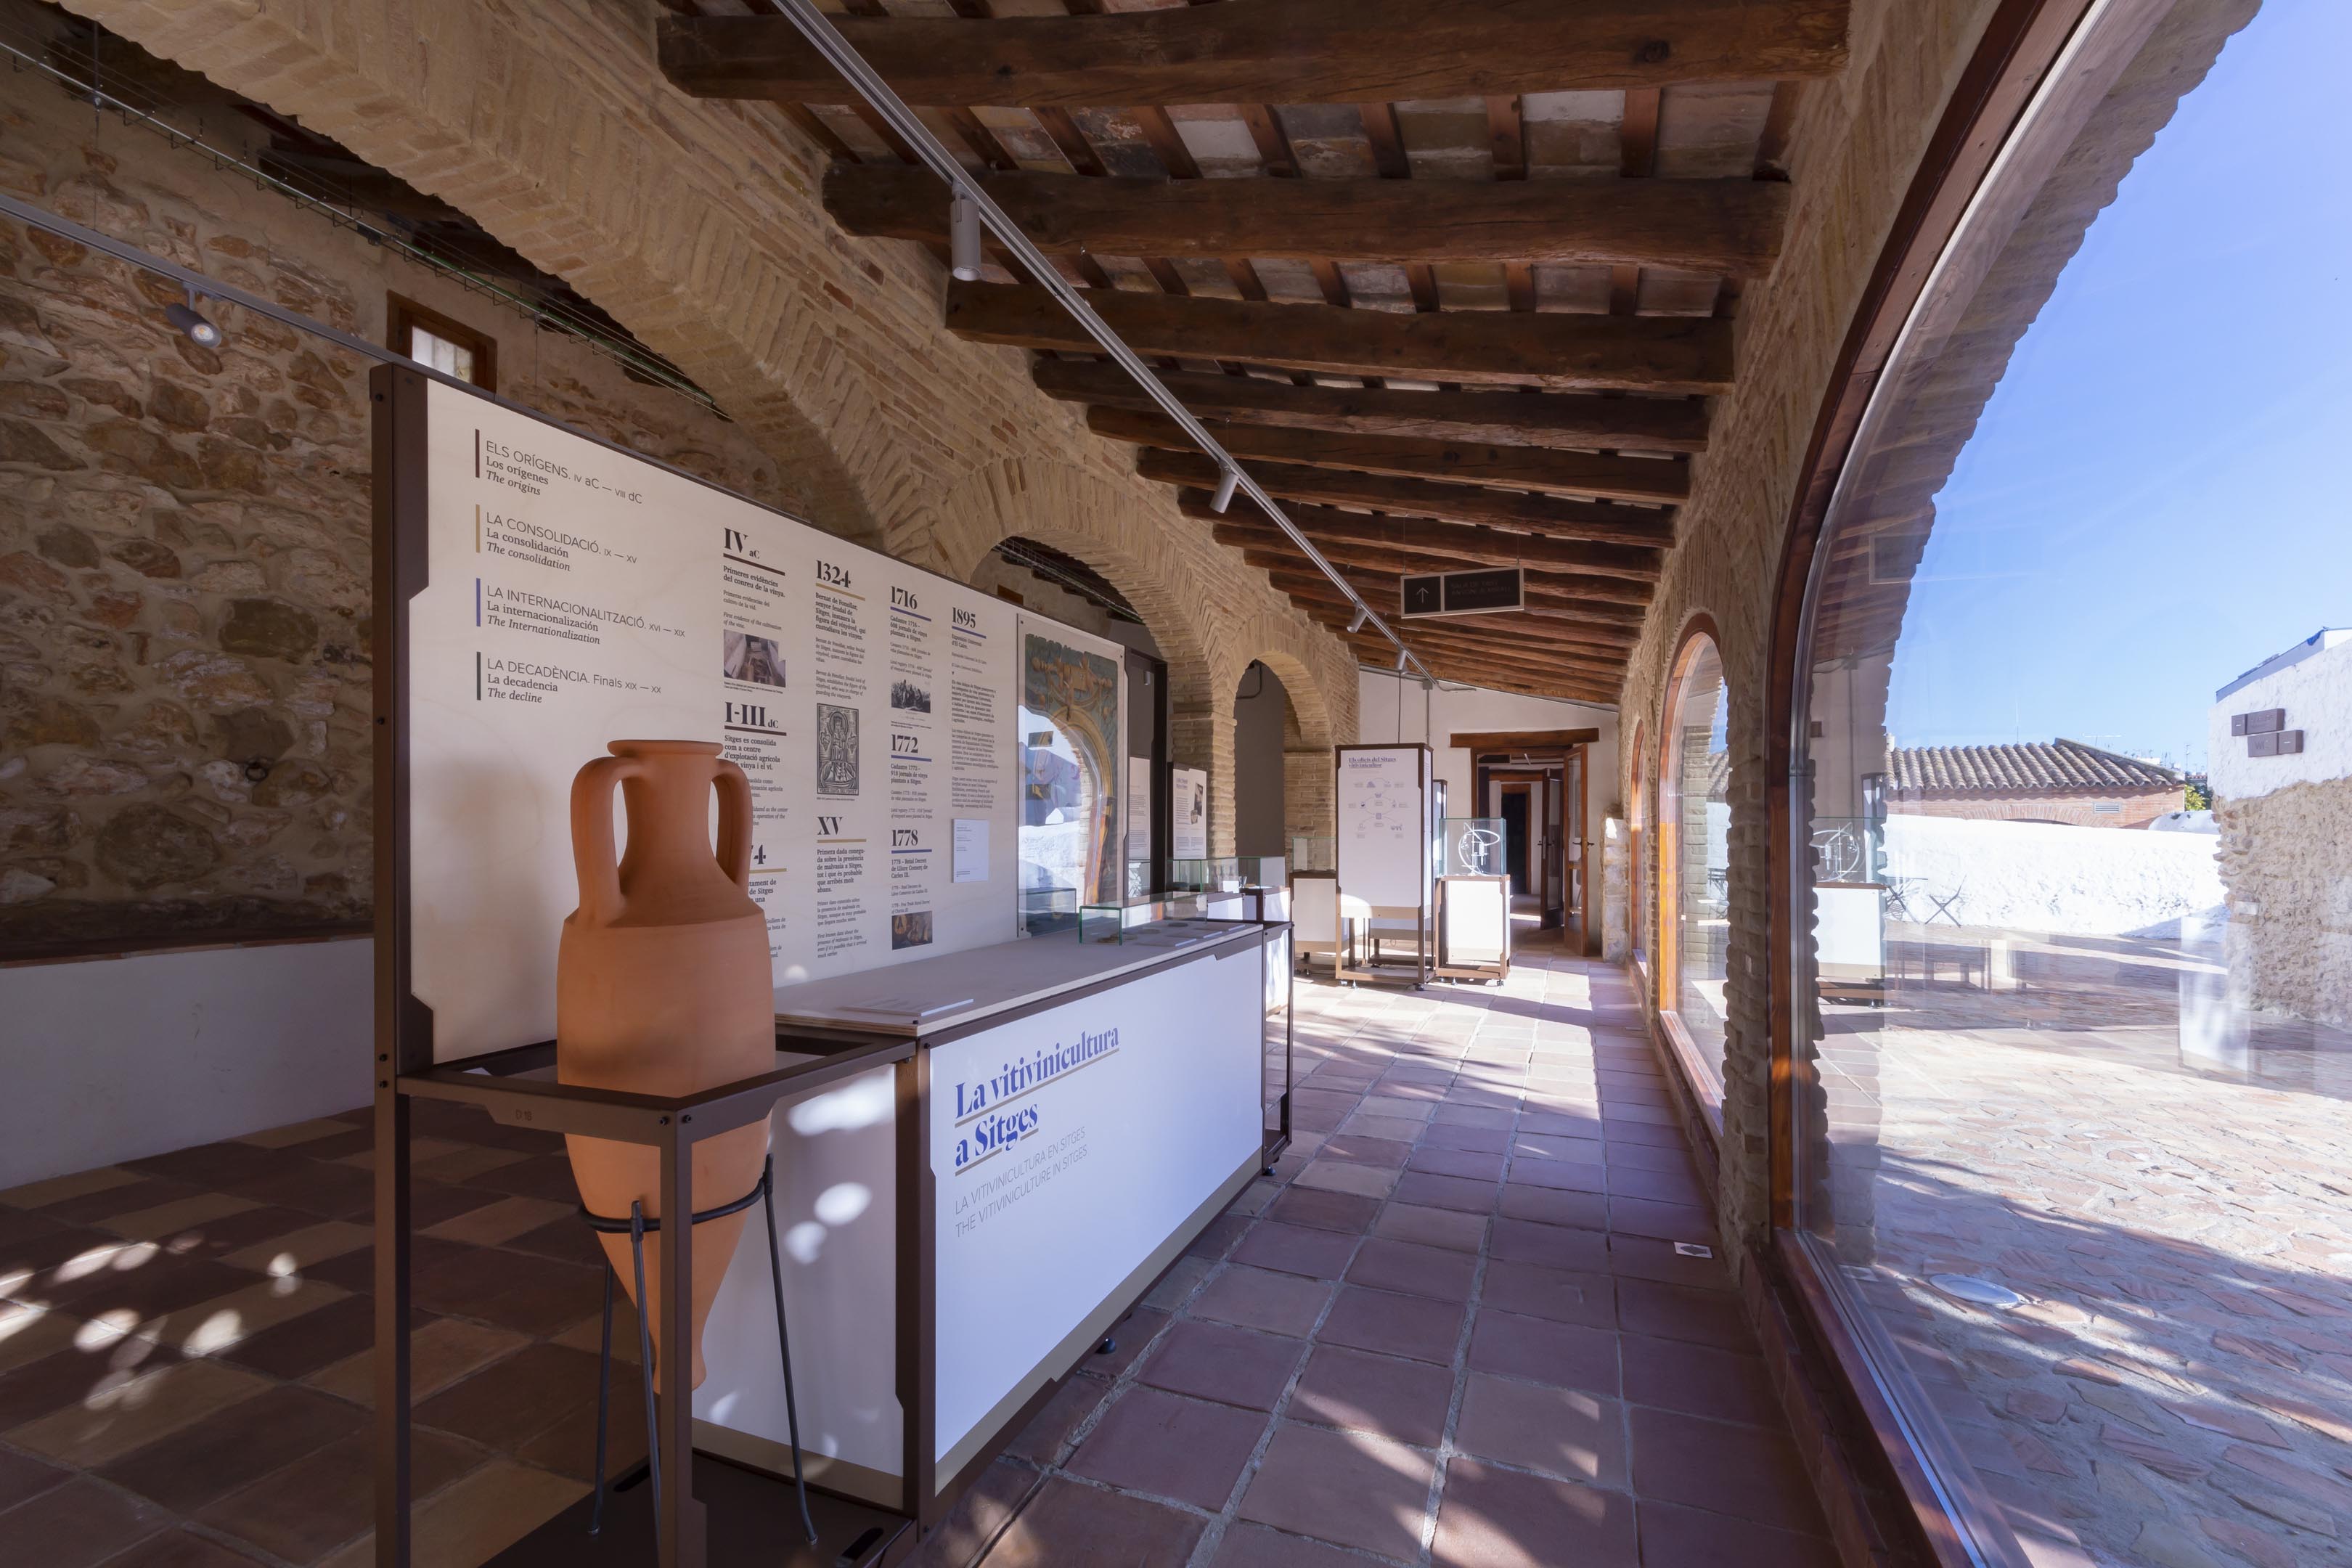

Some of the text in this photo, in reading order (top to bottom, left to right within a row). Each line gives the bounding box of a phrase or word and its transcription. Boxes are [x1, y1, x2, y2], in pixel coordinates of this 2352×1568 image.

[486, 456, 549, 485] Los orígenes
[486, 441, 509, 459] ELS
[513, 451, 571, 480] ORÍGENS.
[584, 477, 600, 489] aC
[628, 491, 642, 504] dC
[486, 470, 541, 496] The origins
[486, 512, 503, 527] LA
[507, 518, 602, 555] CONSOLIDACIÓ.
[626, 555, 637, 564] XV
[486, 528, 568, 558] La consolidación
[724, 527, 760, 559] IV aC
[487, 542, 571, 572] The consolidation
[723, 565, 778, 587] Primeres evidències
[723, 573, 732, 583] del
[734, 577, 754, 588] conreu
[769, 587, 785, 597] vinya.
[816, 560, 851, 589] 1324
[487, 585, 503, 599] LA
[507, 589, 646, 629] INTERNACIONALITZACIÓ.
[674, 629, 685, 637] XIX
[890, 585, 918, 610] 1716
[487, 600, 598, 632] La internacionalización
[815, 615, 830, 624] figura
[952, 606, 976, 629] 1895
[487, 615, 600, 645] The Internationalization
[487, 658, 504, 671] LA
[508, 661, 590, 684] DECADÈNCIA.
[593, 674, 622, 689] Finals
[625, 682, 637, 690] XIX
[487, 674, 558, 692] La decadencia
[488, 687, 542, 703] The decline
[768, 719, 779, 728] dC
[724, 735, 742, 743] Sitges
[891, 734, 918, 754] 1772
[724, 752, 758, 762] d'explotació
[740, 761, 756, 770] vinya
[817, 817, 843, 835] XV
[891, 830, 918, 846] 1778
[955, 1027, 1119, 1119] La vitivinicultura
[955, 1104, 1038, 1167] a Sitges
[955, 1126, 1085, 1215] LA VITIVINICULTURA EN SITGES
[955, 1144, 1087, 1238] THE VITIVINICULTURE IN SITGES
